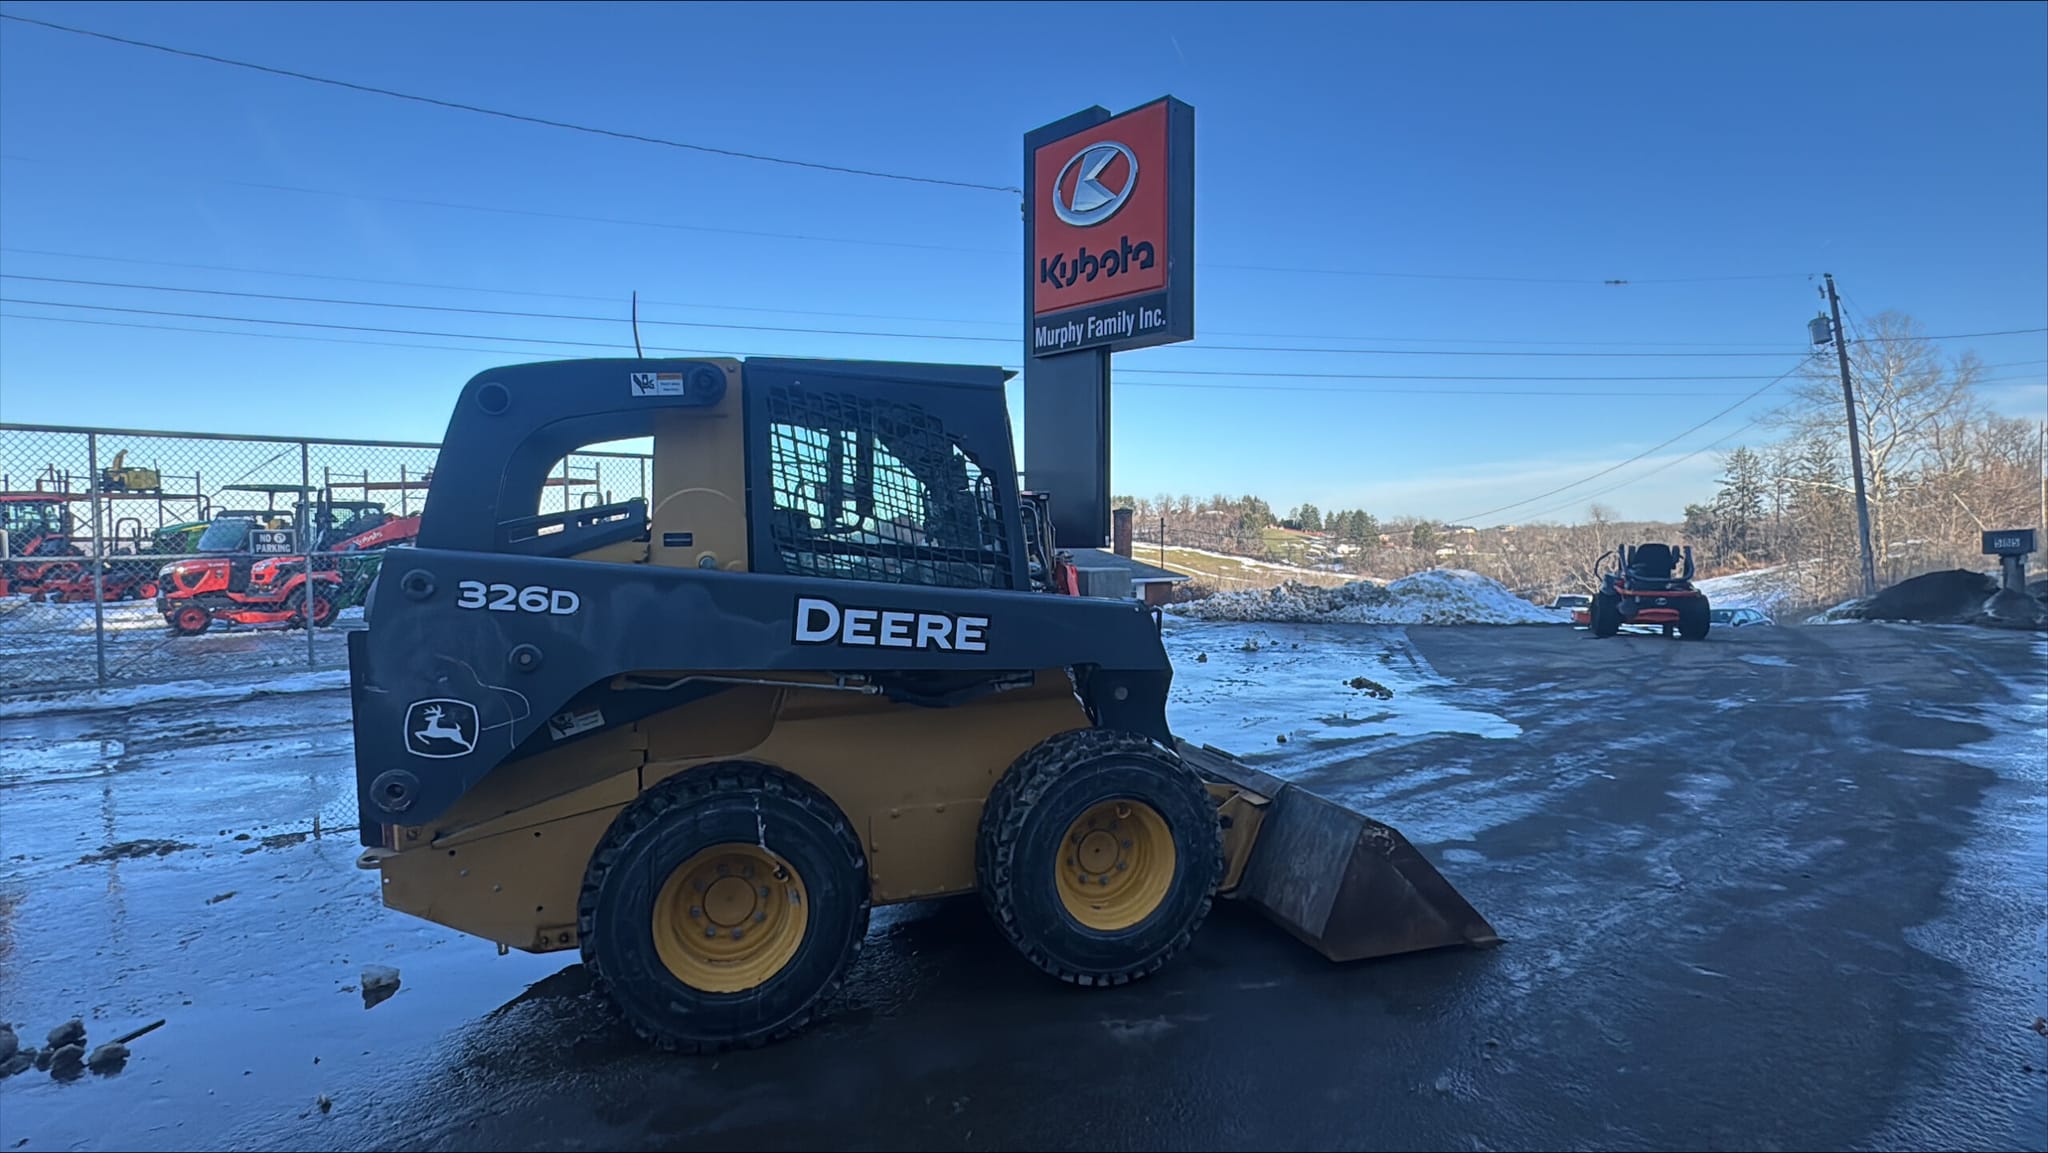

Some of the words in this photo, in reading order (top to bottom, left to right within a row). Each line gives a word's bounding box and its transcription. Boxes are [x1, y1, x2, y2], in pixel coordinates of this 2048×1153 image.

[1041, 235, 1154, 289] Kubota
[1035, 321, 1084, 348] Murphy
[1088, 310, 1135, 338] Family
[1140, 307, 1166, 329] Inc.
[256, 544, 291, 553] PARKING
[259, 534, 271, 543] NO
[457, 580, 580, 615] 326D
[795, 598, 989, 651] DEERE
